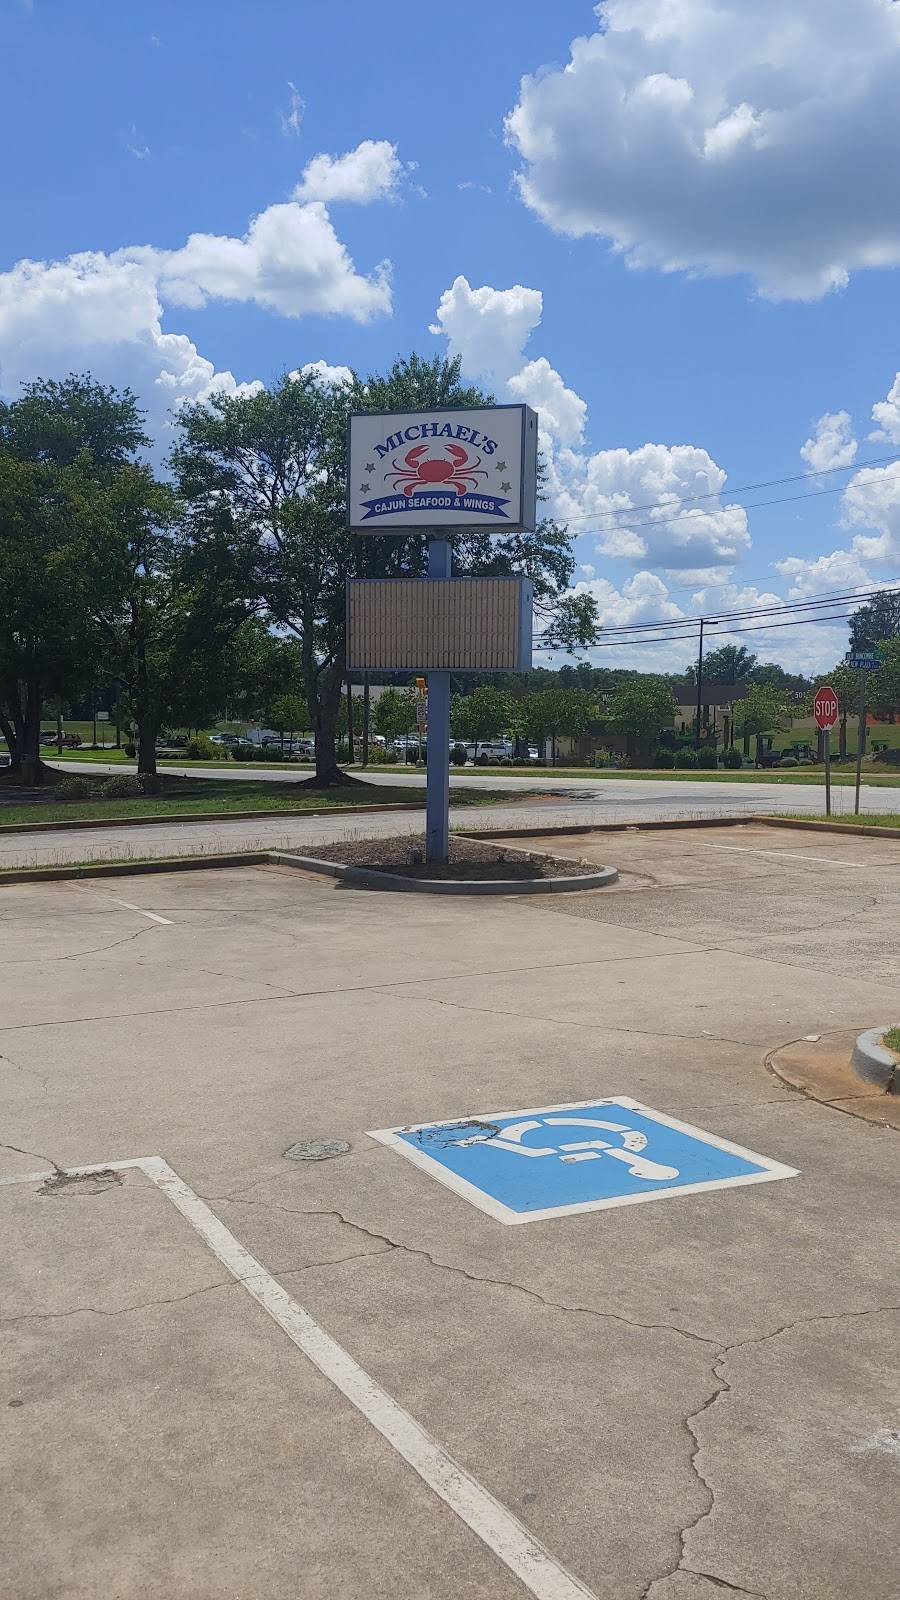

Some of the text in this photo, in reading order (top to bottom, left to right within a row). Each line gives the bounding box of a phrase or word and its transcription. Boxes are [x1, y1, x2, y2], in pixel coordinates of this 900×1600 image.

[373, 423, 498, 459] MICHAEL'S
[374, 497, 495, 513] CAJUN SEAFOOD & WINGS
[816, 700, 836, 716] STOP
